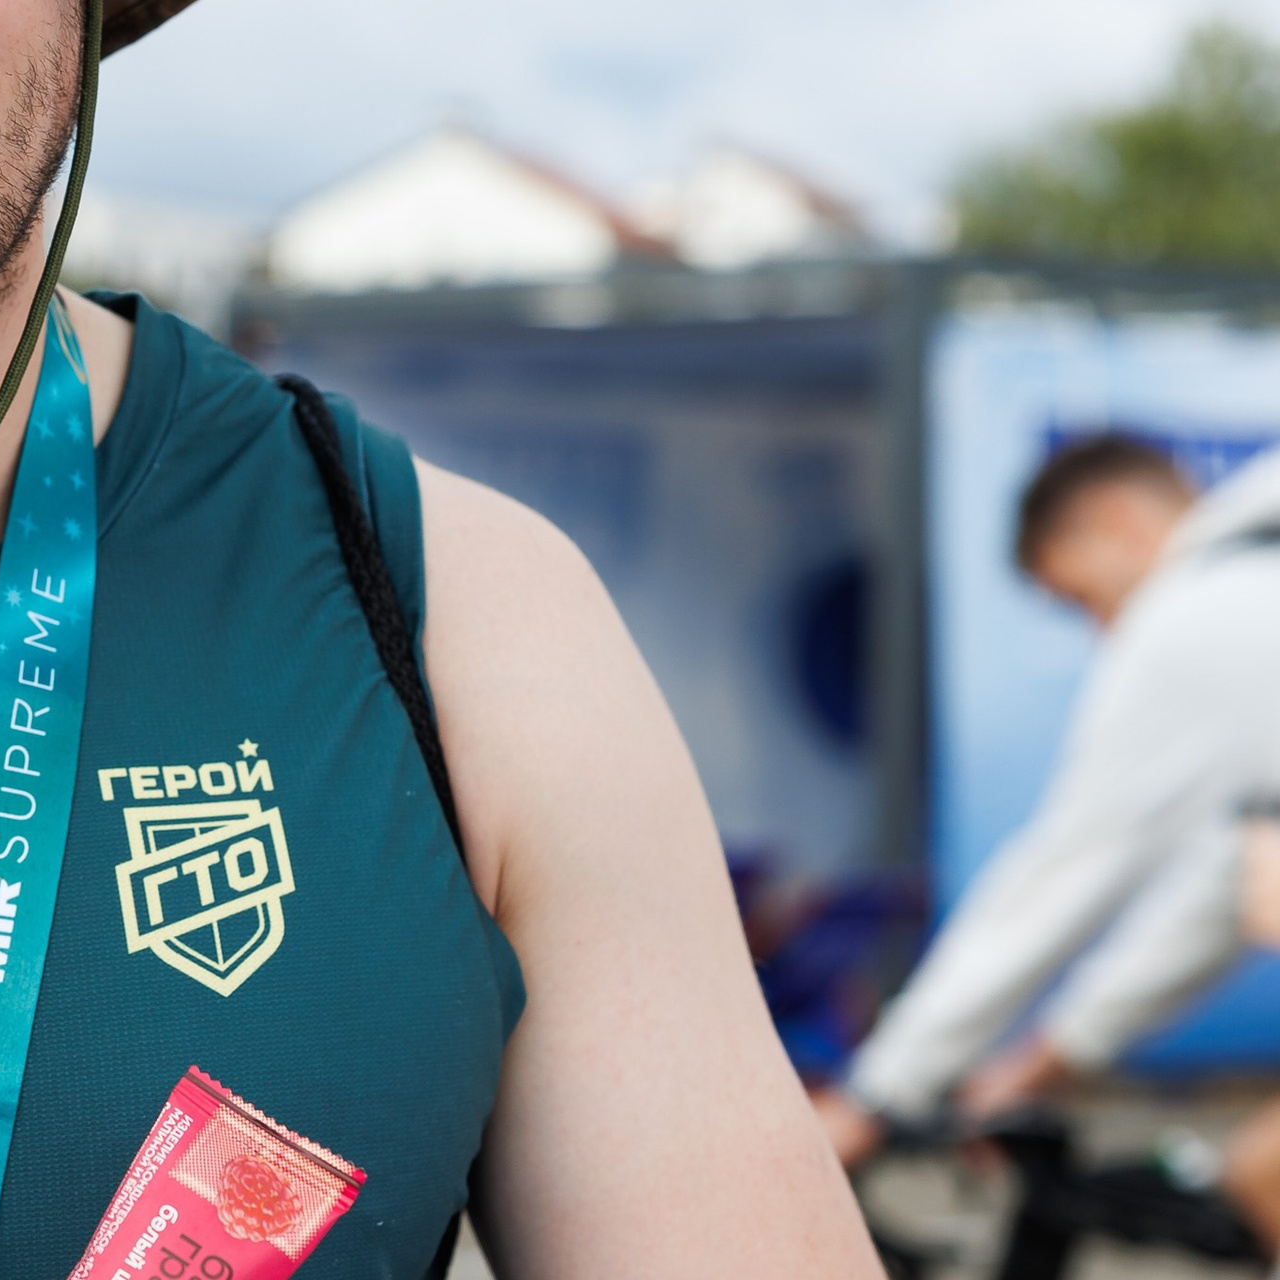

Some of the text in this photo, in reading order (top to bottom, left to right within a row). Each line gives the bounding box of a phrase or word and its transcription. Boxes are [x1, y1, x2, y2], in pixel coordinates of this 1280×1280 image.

[98, 739, 274, 801] ГЕРОЙ
[143, 838, 268, 926] ГТО
[125, 1205, 178, 1269] белый
